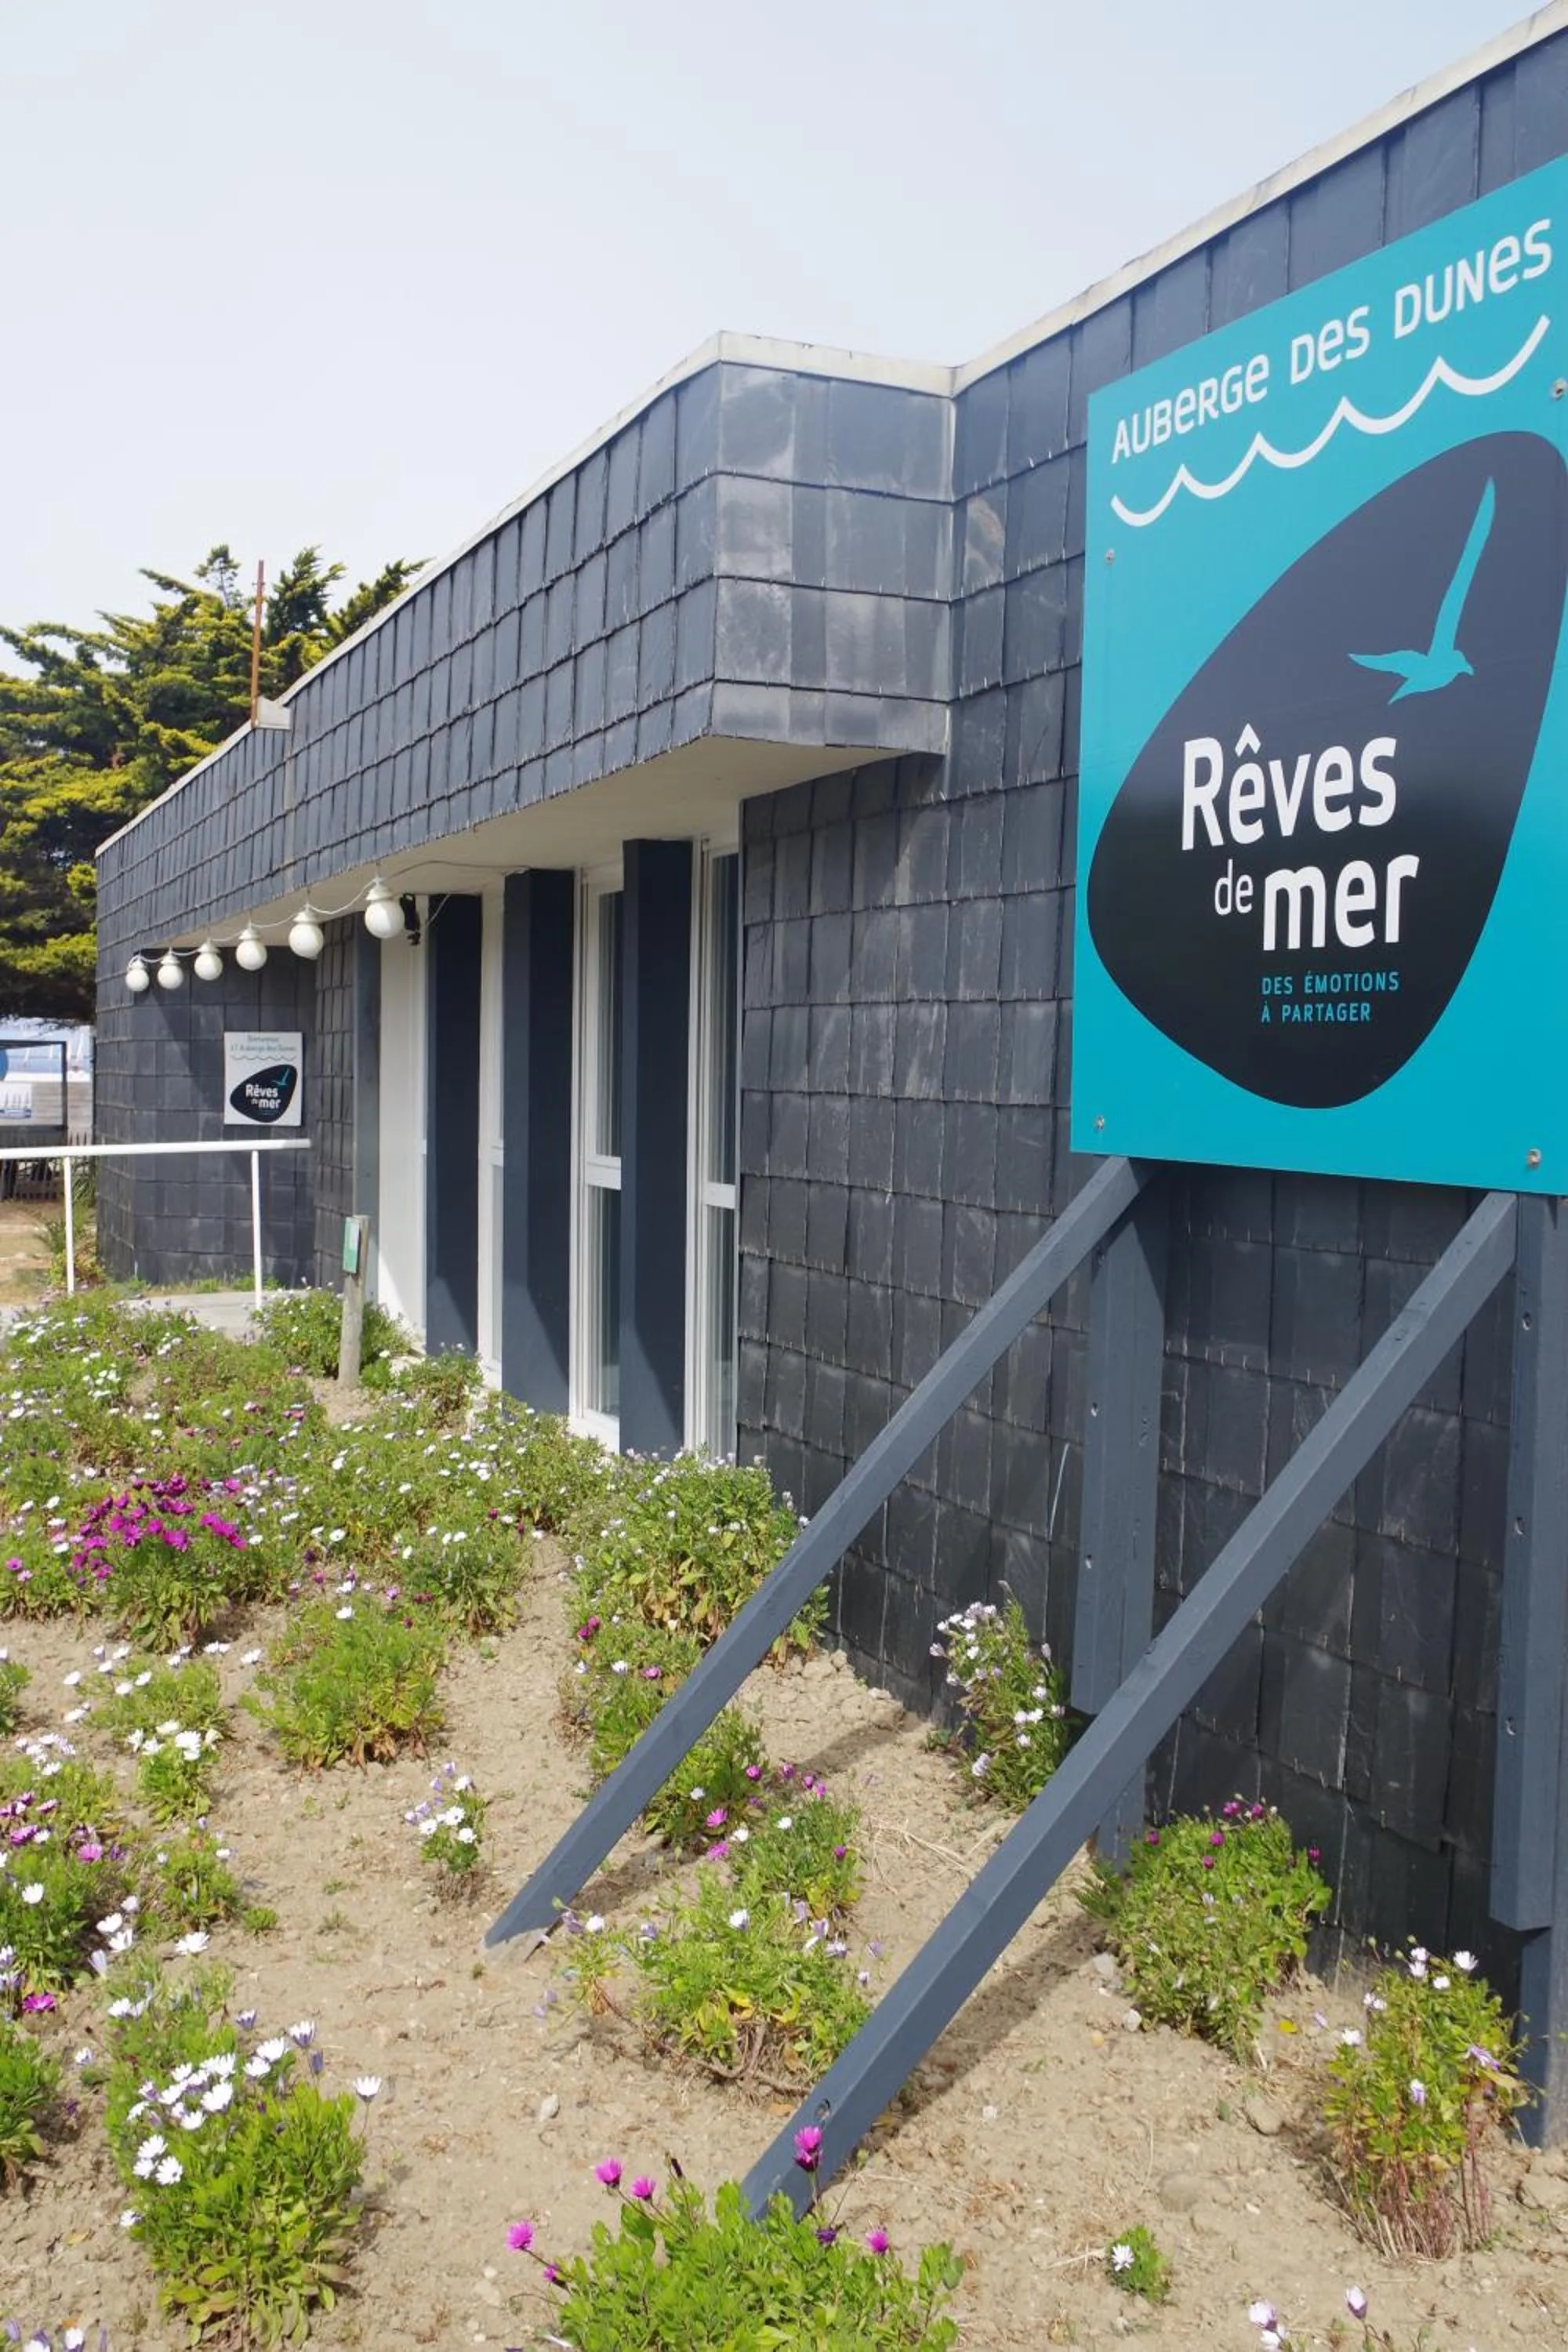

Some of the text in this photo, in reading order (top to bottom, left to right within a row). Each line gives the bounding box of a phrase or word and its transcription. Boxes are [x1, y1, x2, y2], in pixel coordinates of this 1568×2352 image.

[1181, 723, 1397, 851] Rêves
[1214, 854, 1420, 951] de mer
[1261, 970, 1399, 995] DES ÉMOTIONS
[1261, 1000, 1371, 1022] À PARTAGER
[258, 1098, 281, 1109] mer
